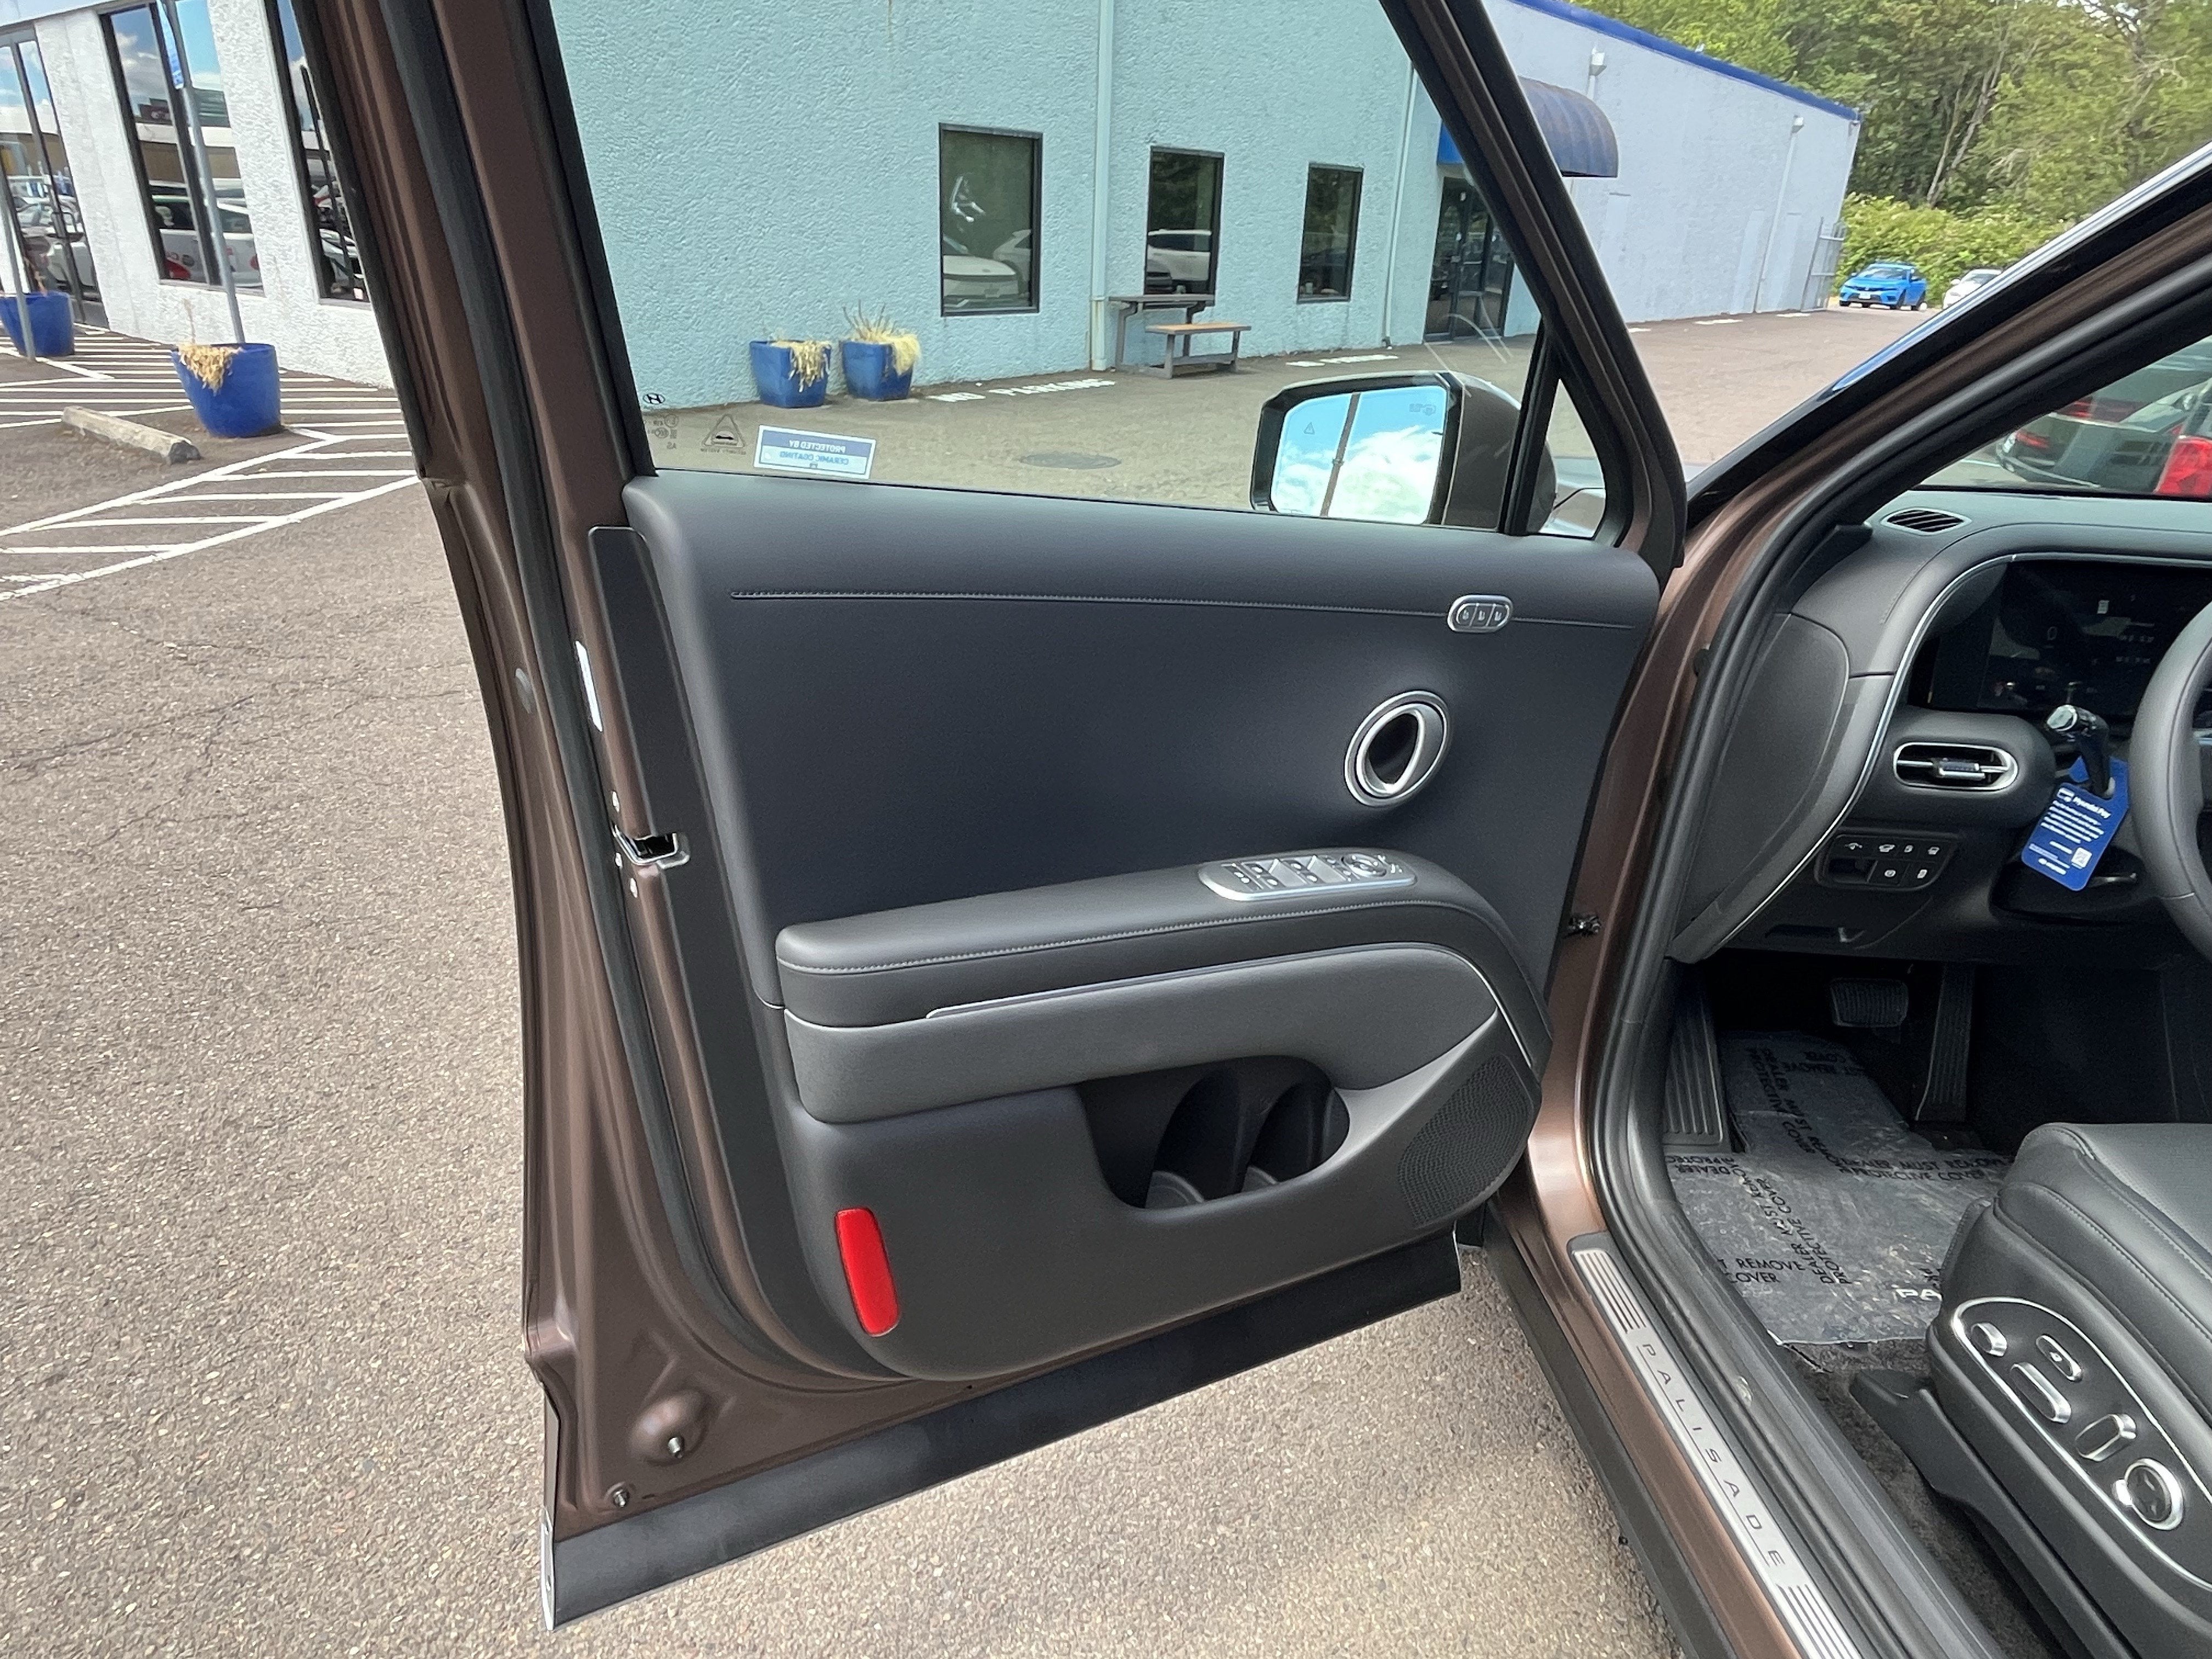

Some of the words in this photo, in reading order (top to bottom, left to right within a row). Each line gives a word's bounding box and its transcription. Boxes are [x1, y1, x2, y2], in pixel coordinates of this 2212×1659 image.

[1735, 1257, 1806, 1271] REMOVE
[1787, 1217, 1853, 1285] PROTECTIVE
[1791, 1243, 1835, 1284] DEALER
[1641, 1343, 1786, 1567] PALISADE
